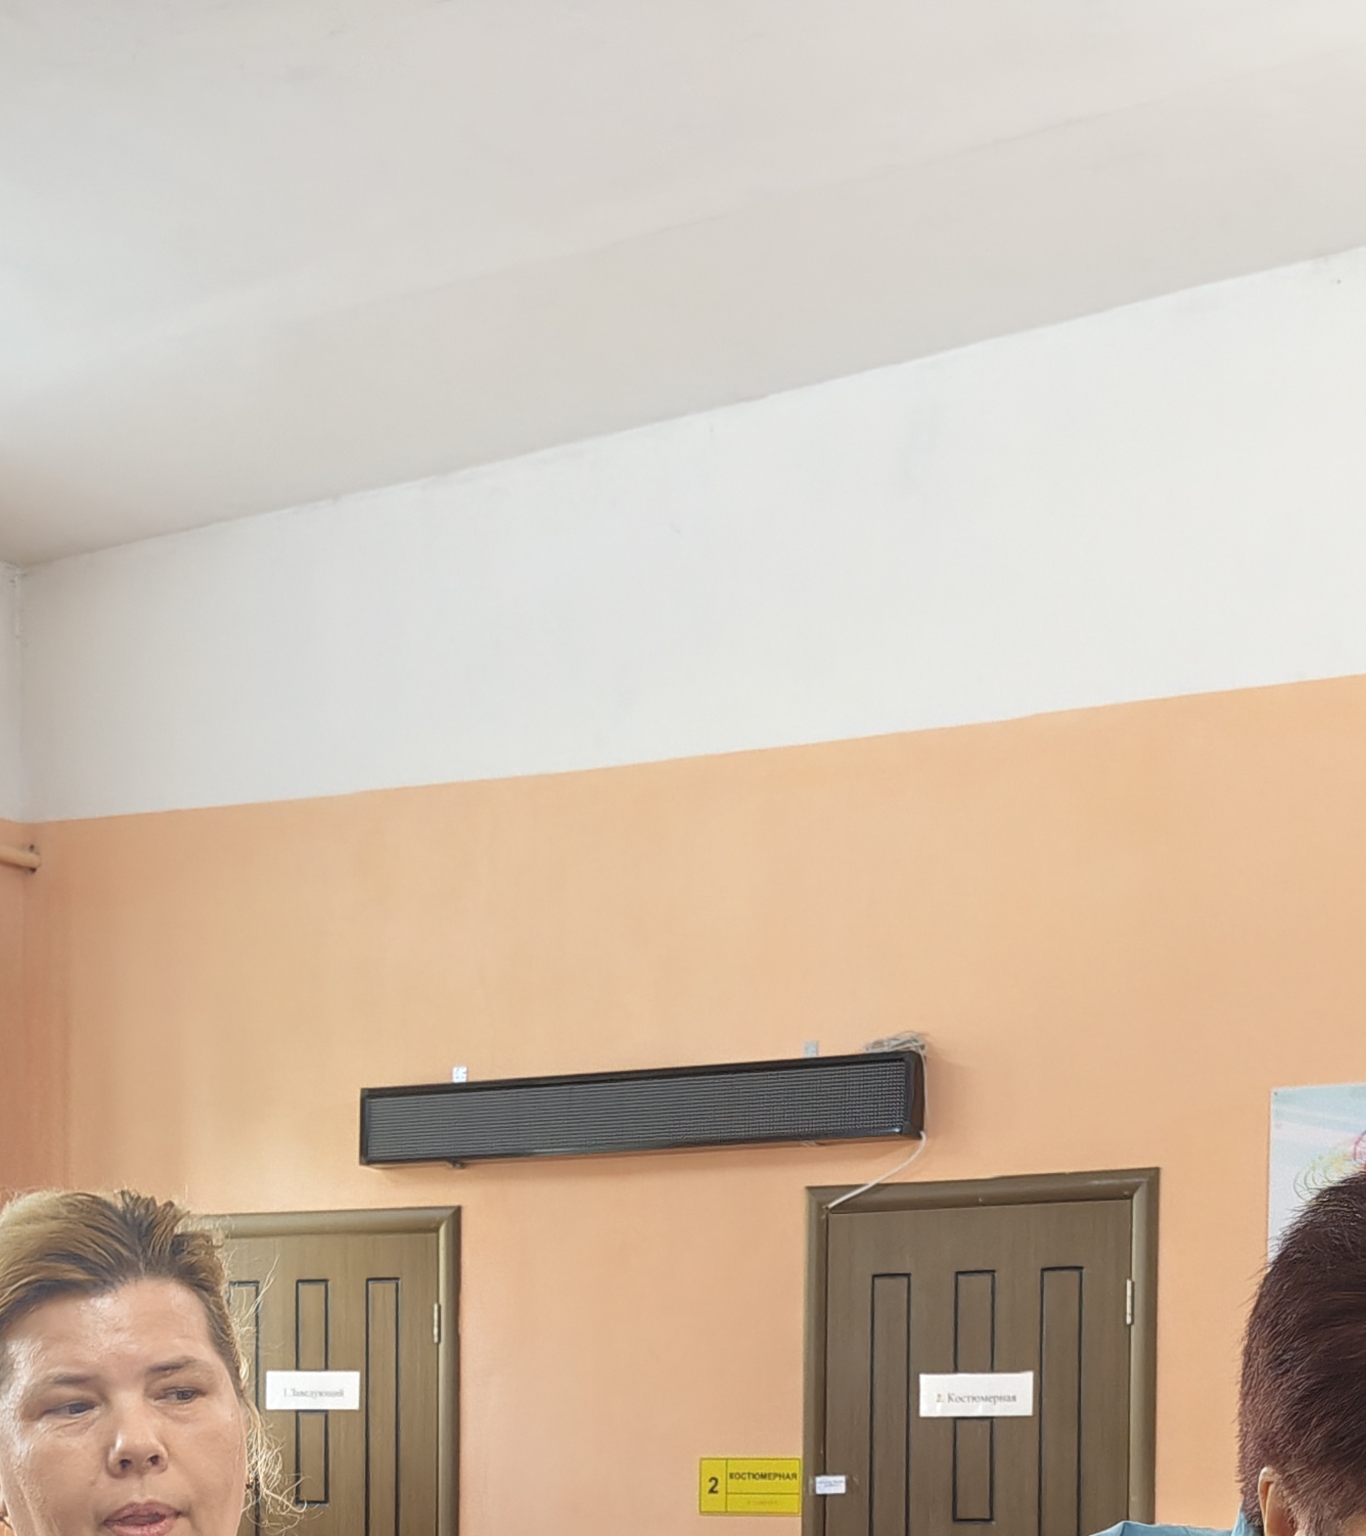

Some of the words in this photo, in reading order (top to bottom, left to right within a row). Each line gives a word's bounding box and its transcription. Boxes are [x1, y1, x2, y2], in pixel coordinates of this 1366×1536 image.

[947, 1391, 1018, 1405] Костюмерная
[728, 1471, 798, 1481] КОСТЮМЕРНАЯ
[707, 1476, 720, 1495] 2
